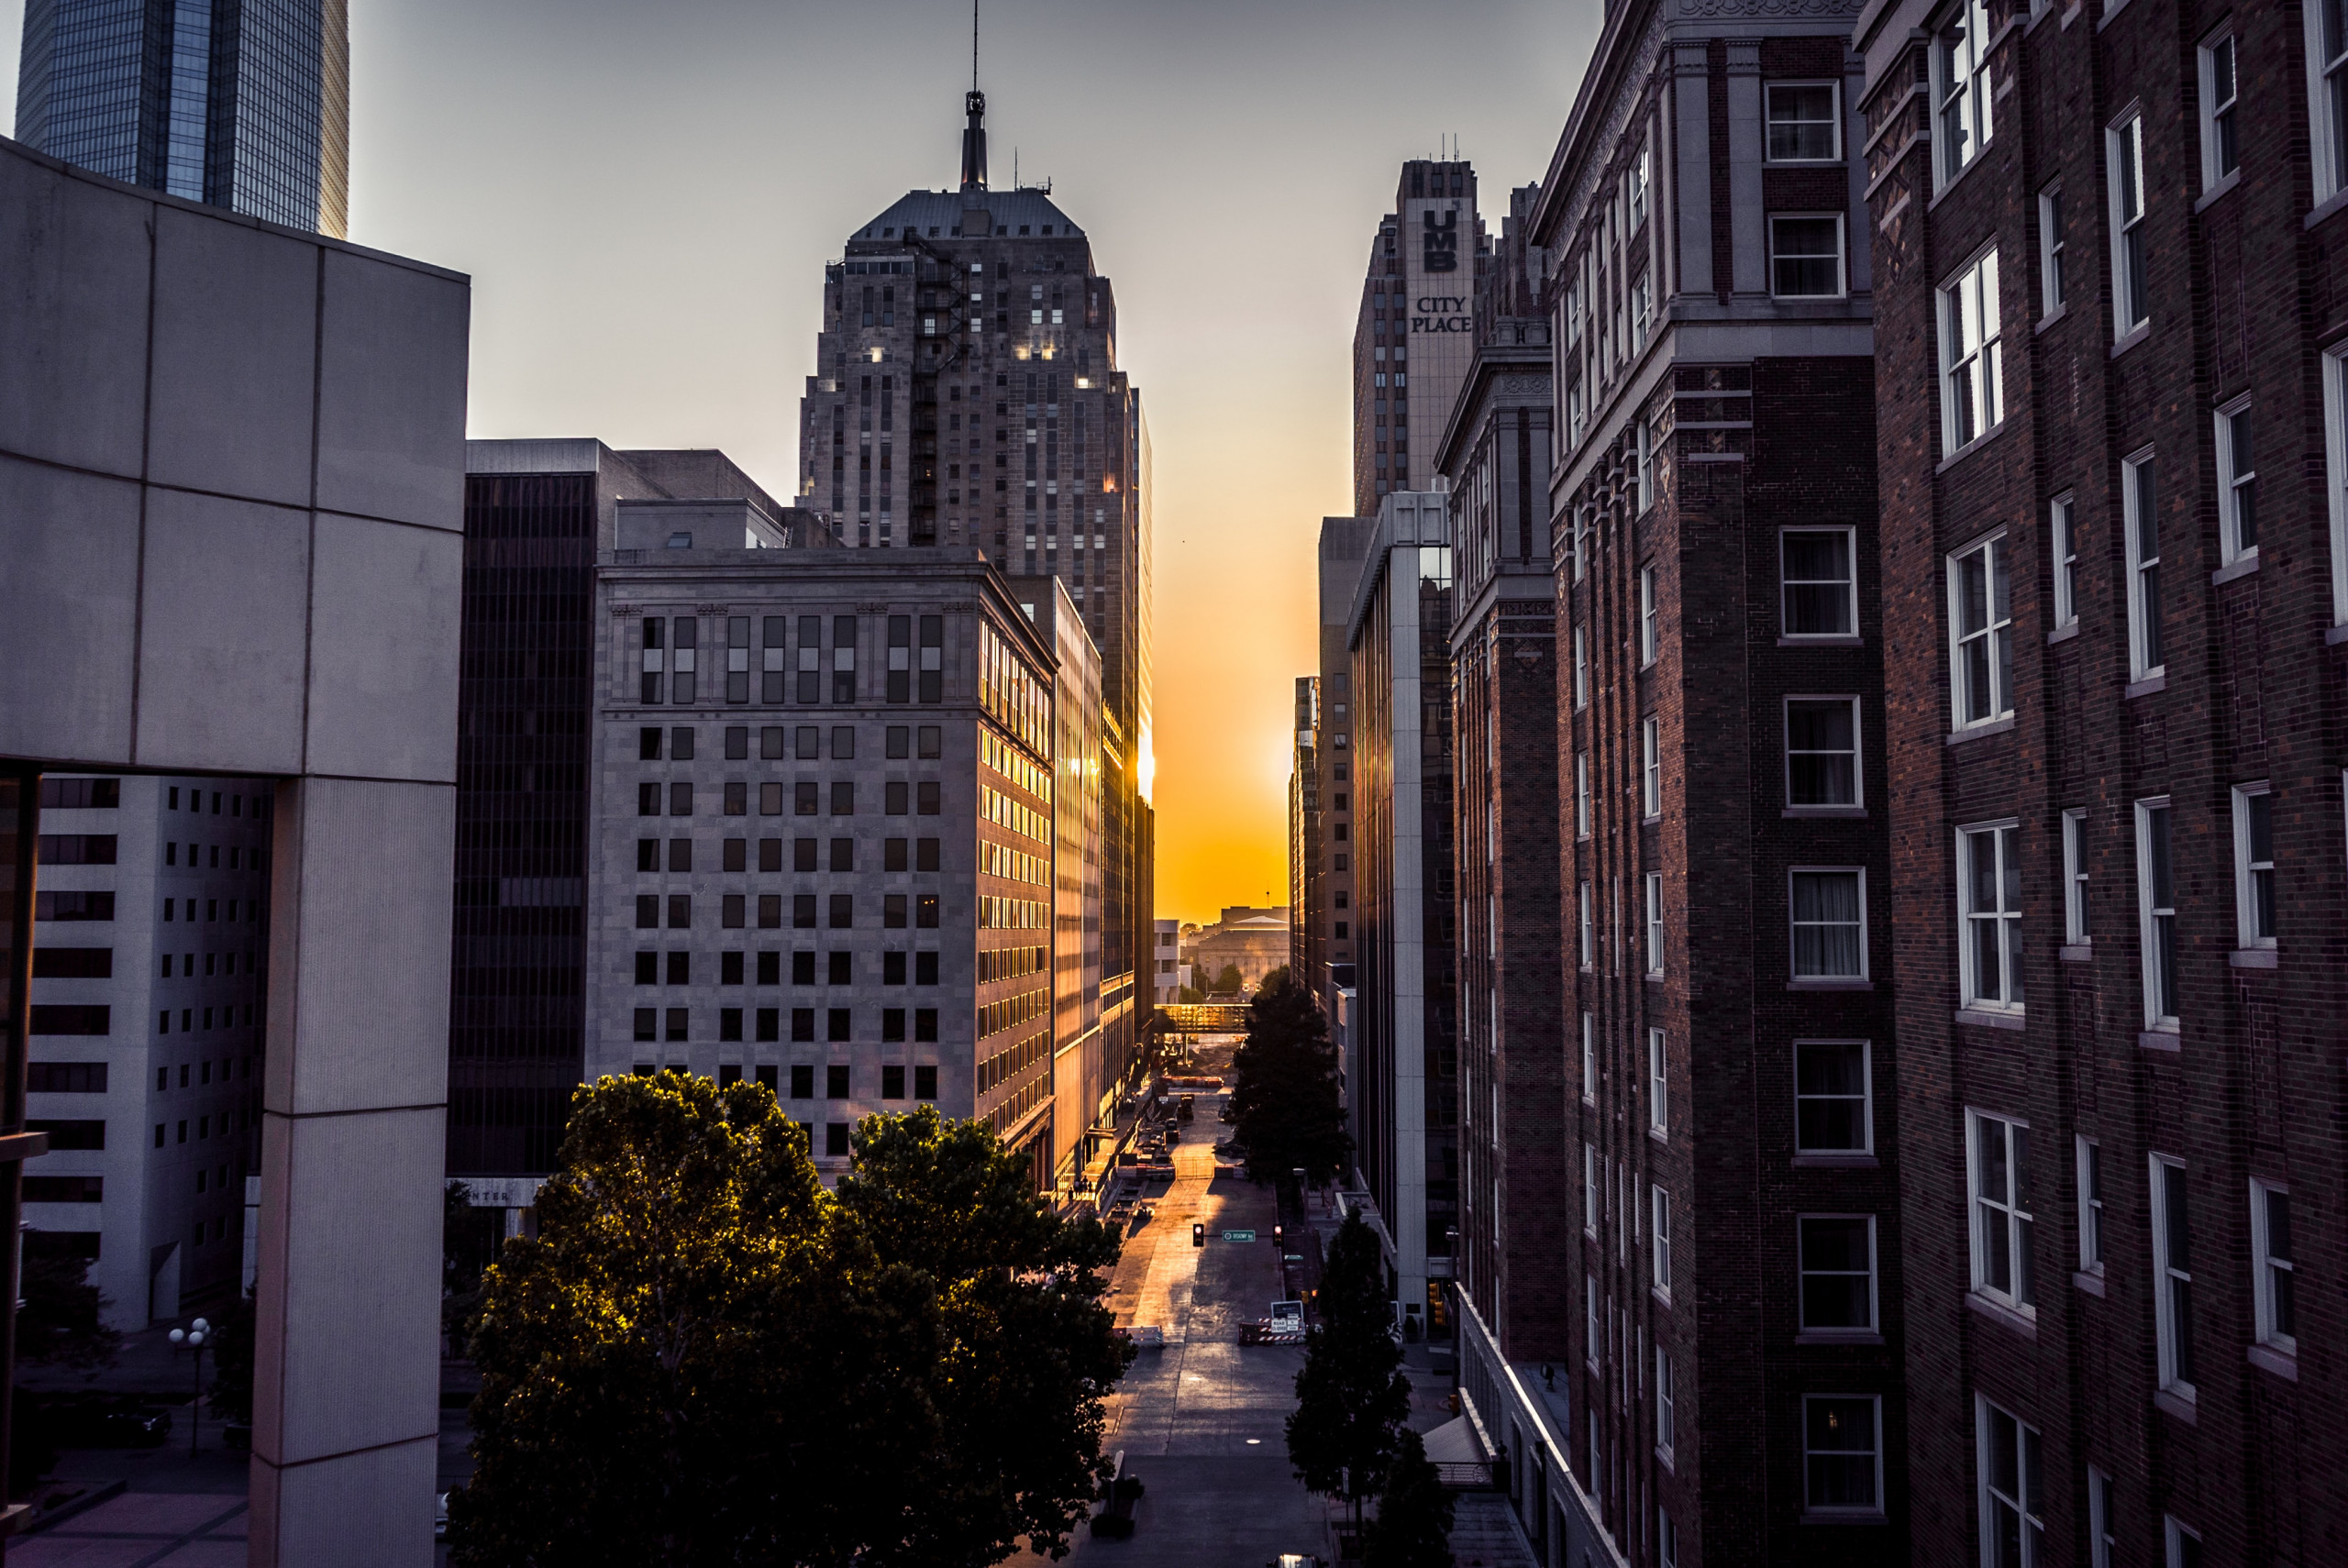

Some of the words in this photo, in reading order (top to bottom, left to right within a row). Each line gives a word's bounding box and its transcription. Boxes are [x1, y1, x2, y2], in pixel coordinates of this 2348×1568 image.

[1423, 210, 1457, 272] UMB
[1417, 296, 1467, 314] CITY
[1412, 317, 1472, 333] PLACE
